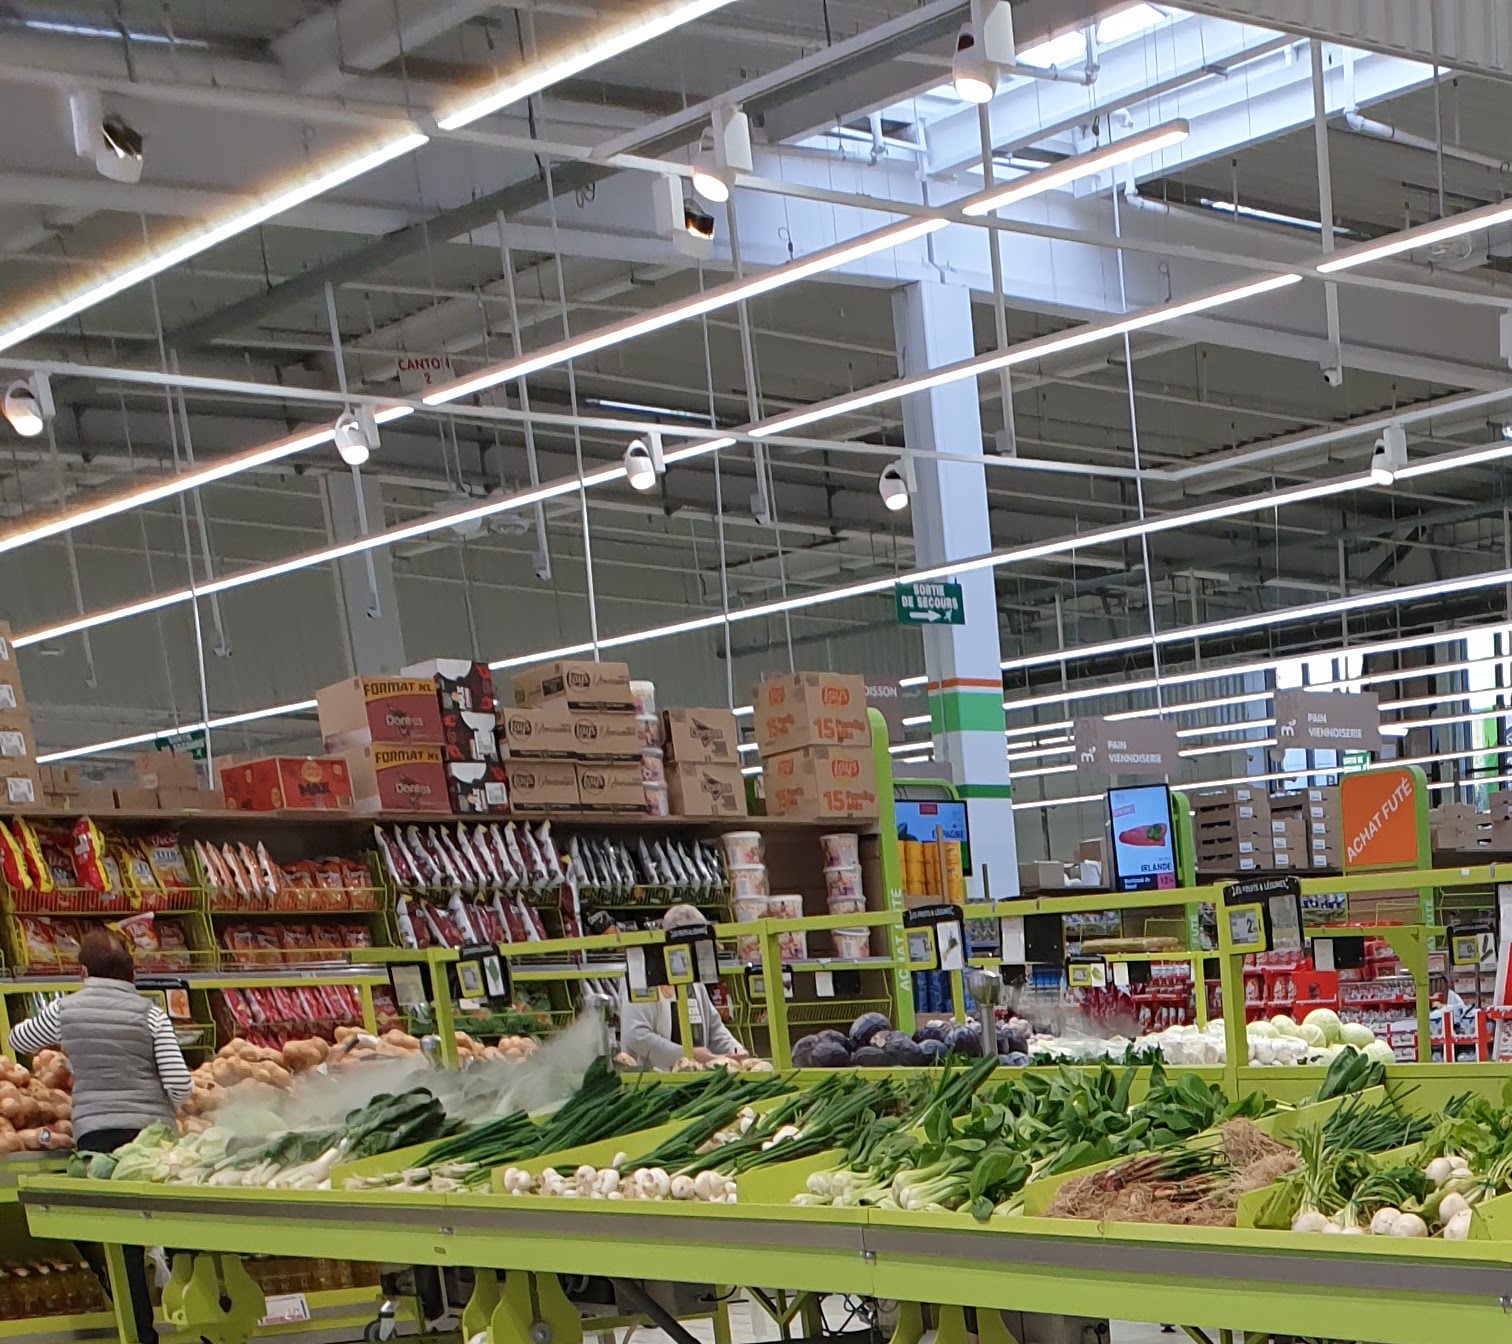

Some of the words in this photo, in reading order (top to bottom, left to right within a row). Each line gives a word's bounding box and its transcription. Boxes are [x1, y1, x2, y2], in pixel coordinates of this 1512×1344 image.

[913, 583, 945, 597] SORTIE
[901, 595, 915, 608] DE
[916, 596, 958, 610] SECOURS
[364, 682, 415, 696] FORMAT
[418, 682, 433, 692] XL
[864, 685, 898, 698] OISSON
[376, 751, 424, 763] FORMAT
[1346, 811, 1383, 864] ACHAT
[1381, 776, 1413, 820] FUTÉ
[1141, 862, 1172, 872] IRLANDE
